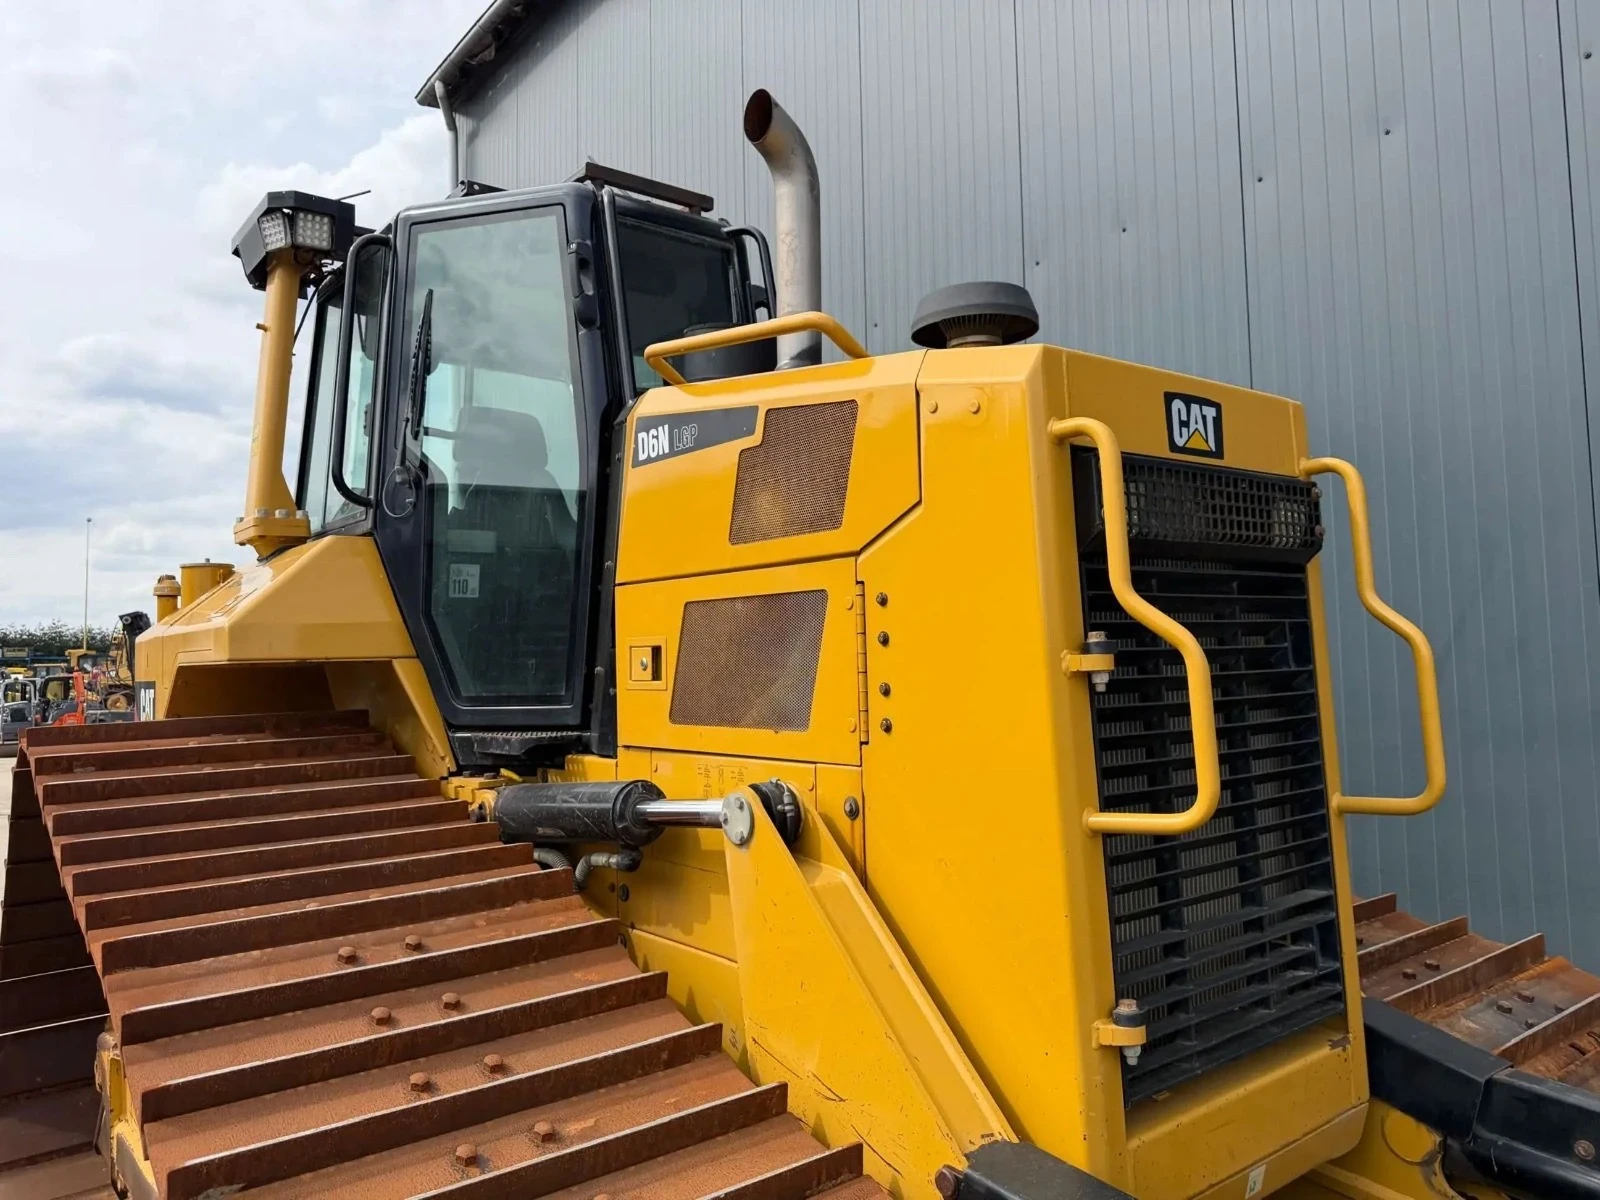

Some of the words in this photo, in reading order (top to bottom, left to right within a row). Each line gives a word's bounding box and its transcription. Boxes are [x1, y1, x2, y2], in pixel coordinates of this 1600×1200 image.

[637, 424, 670, 461] D6N
[673, 423, 699, 451] LGP
[1171, 398, 1217, 452] CAT
[452, 579, 469, 595] 110
[140, 687, 155, 722] CAT
